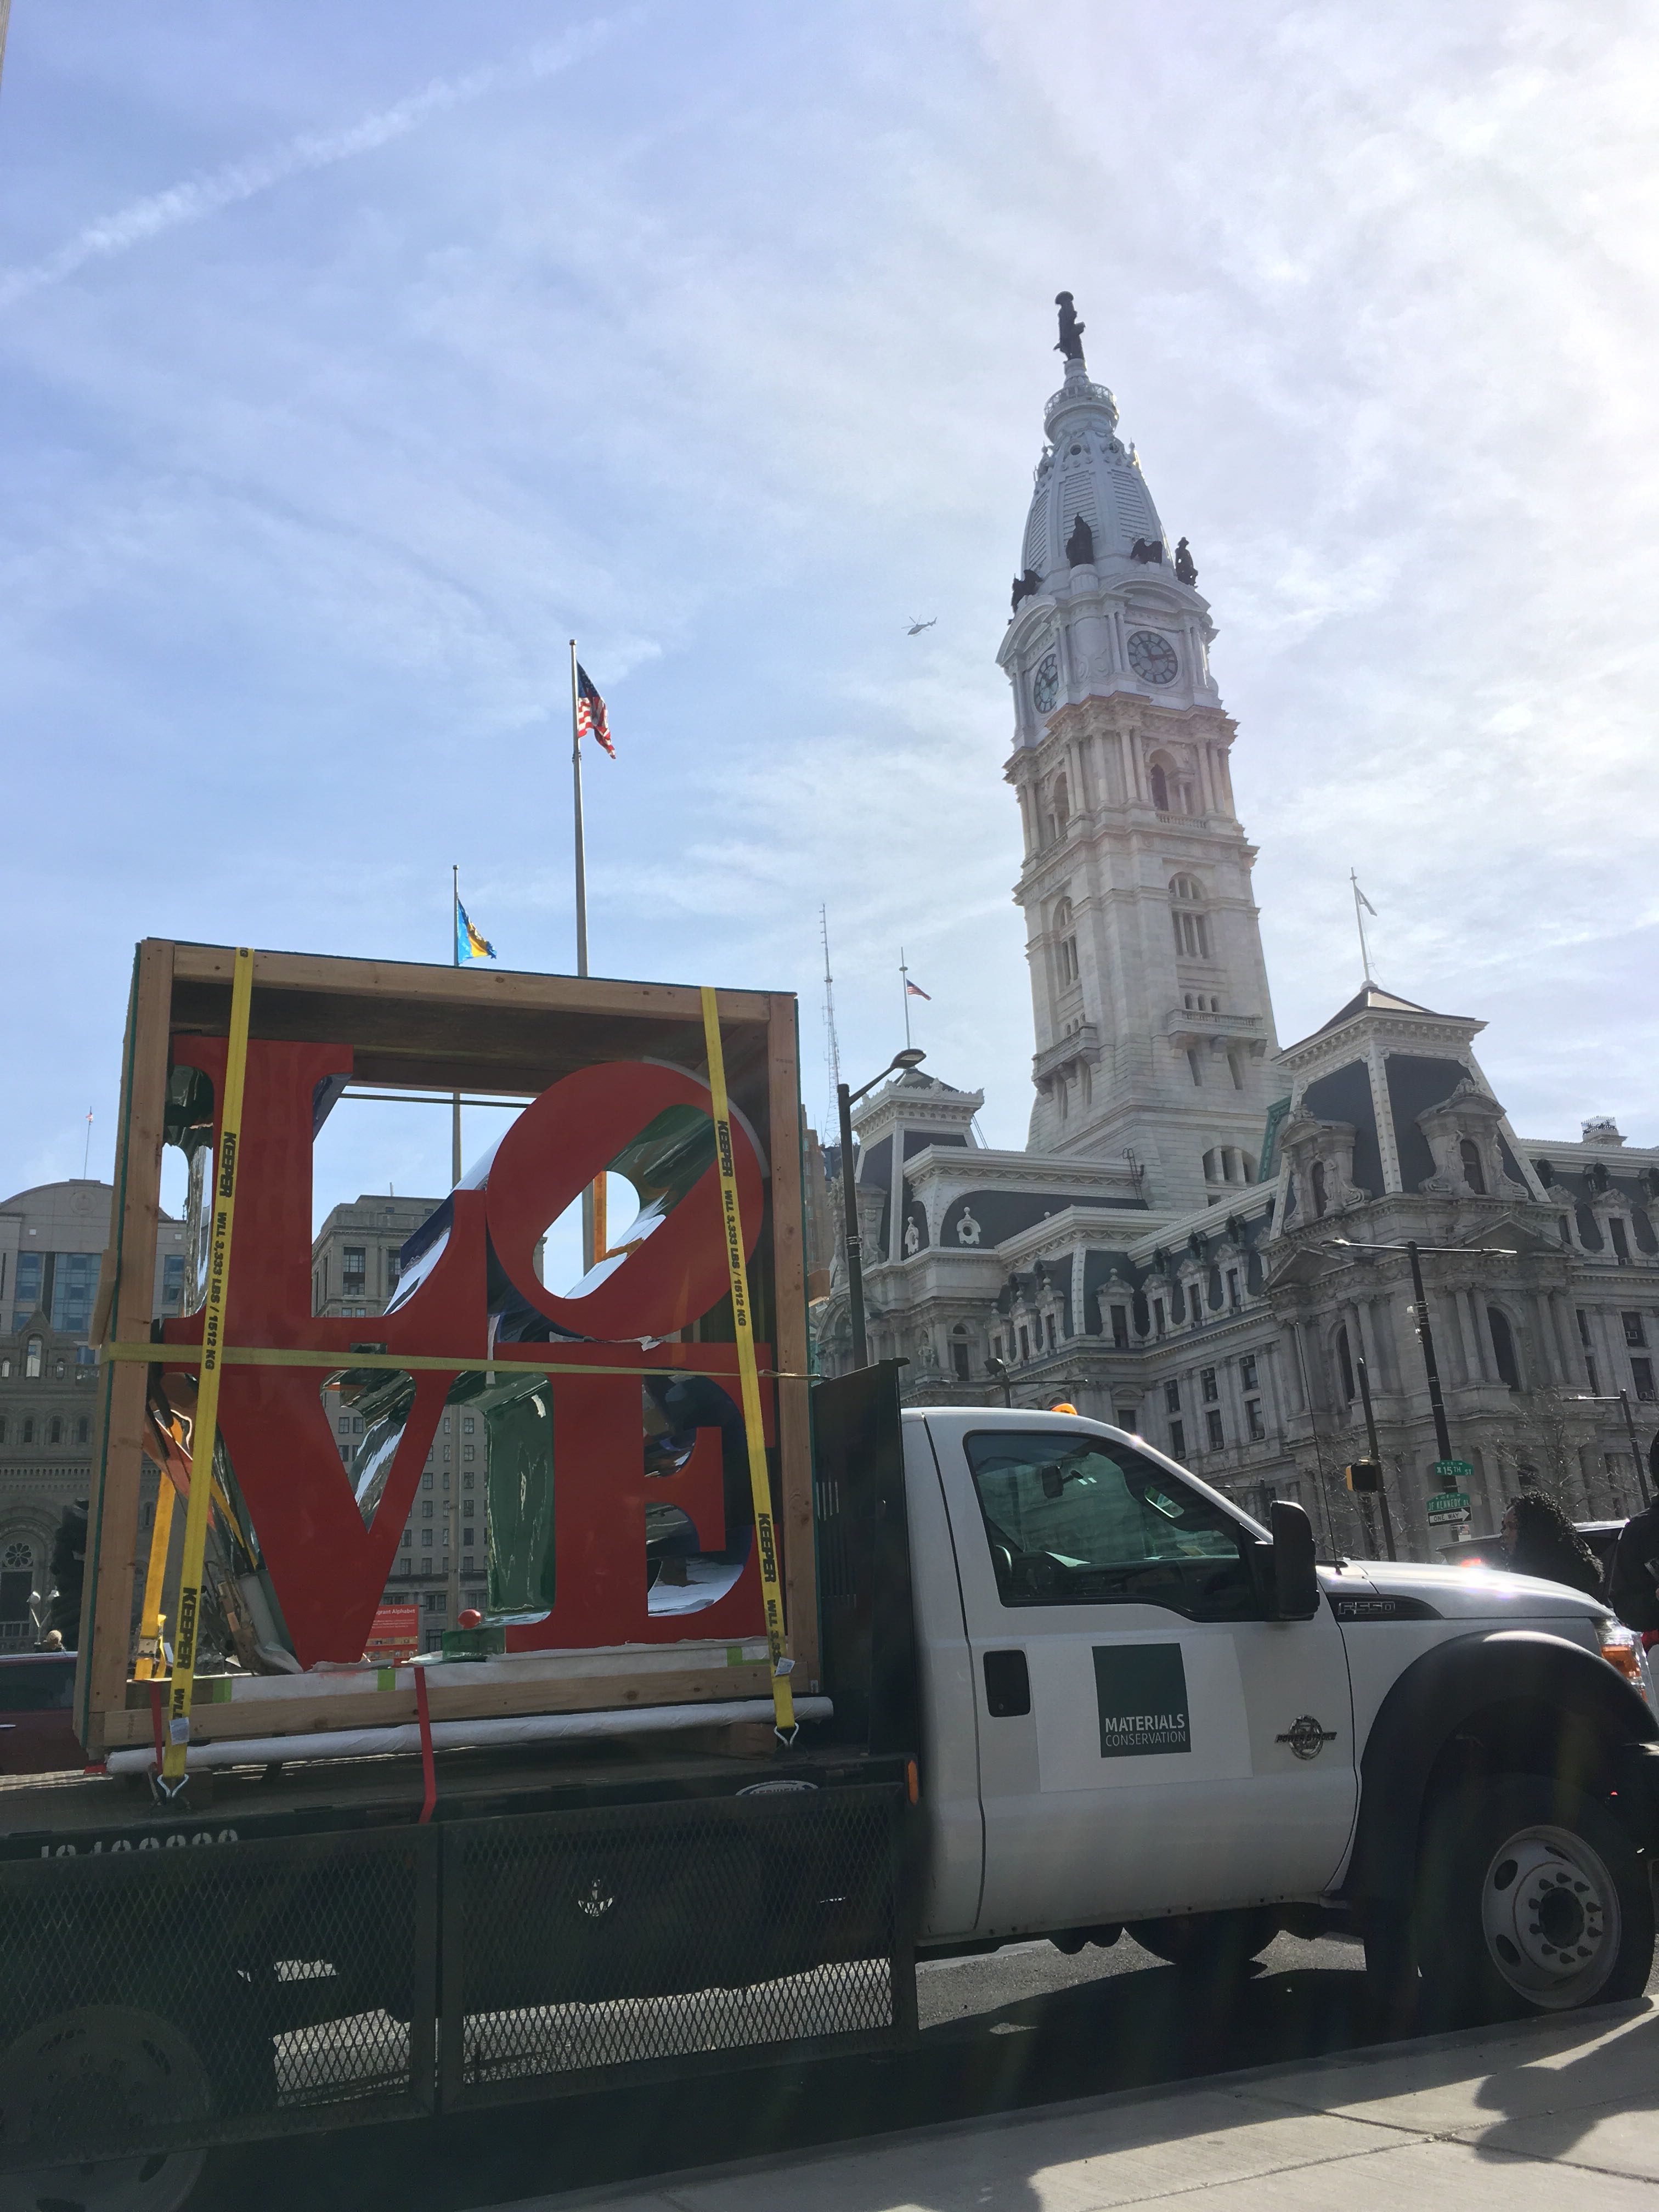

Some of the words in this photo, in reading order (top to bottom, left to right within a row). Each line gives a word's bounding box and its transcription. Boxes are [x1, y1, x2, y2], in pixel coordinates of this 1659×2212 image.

[718, 1120, 733, 1177] KEEPER
[219, 1131, 236, 1198] KEEPER
[724, 1190, 733, 1212] WLL
[216, 1212, 227, 1237] WLL
[727, 1215, 737, 1245] 3,333
[213, 1240, 224, 1276] 3,333
[730, 1247, 740, 1269] LBS
[211, 1278, 222, 1304] LBS
[733, 1278, 744, 1306] 1512
[207, 1315, 218, 1346] 1512
[737, 1309, 746, 1327] KG
[205, 1349, 216, 1370] KG
[1443, 1466, 1461, 1475] 15TH
[1428, 1502, 1434, 1511] JF
[1437, 1498, 1460, 1510] KENNEDY
[758, 1513, 776, 1582] KEEPER
[767, 1599, 777, 1627] WLL
[177, 1587, 197, 1669] KEEPER
[1105, 1714, 1185, 1733] MATERIALS
[1105, 1731, 1186, 1747] CONSERVATION
